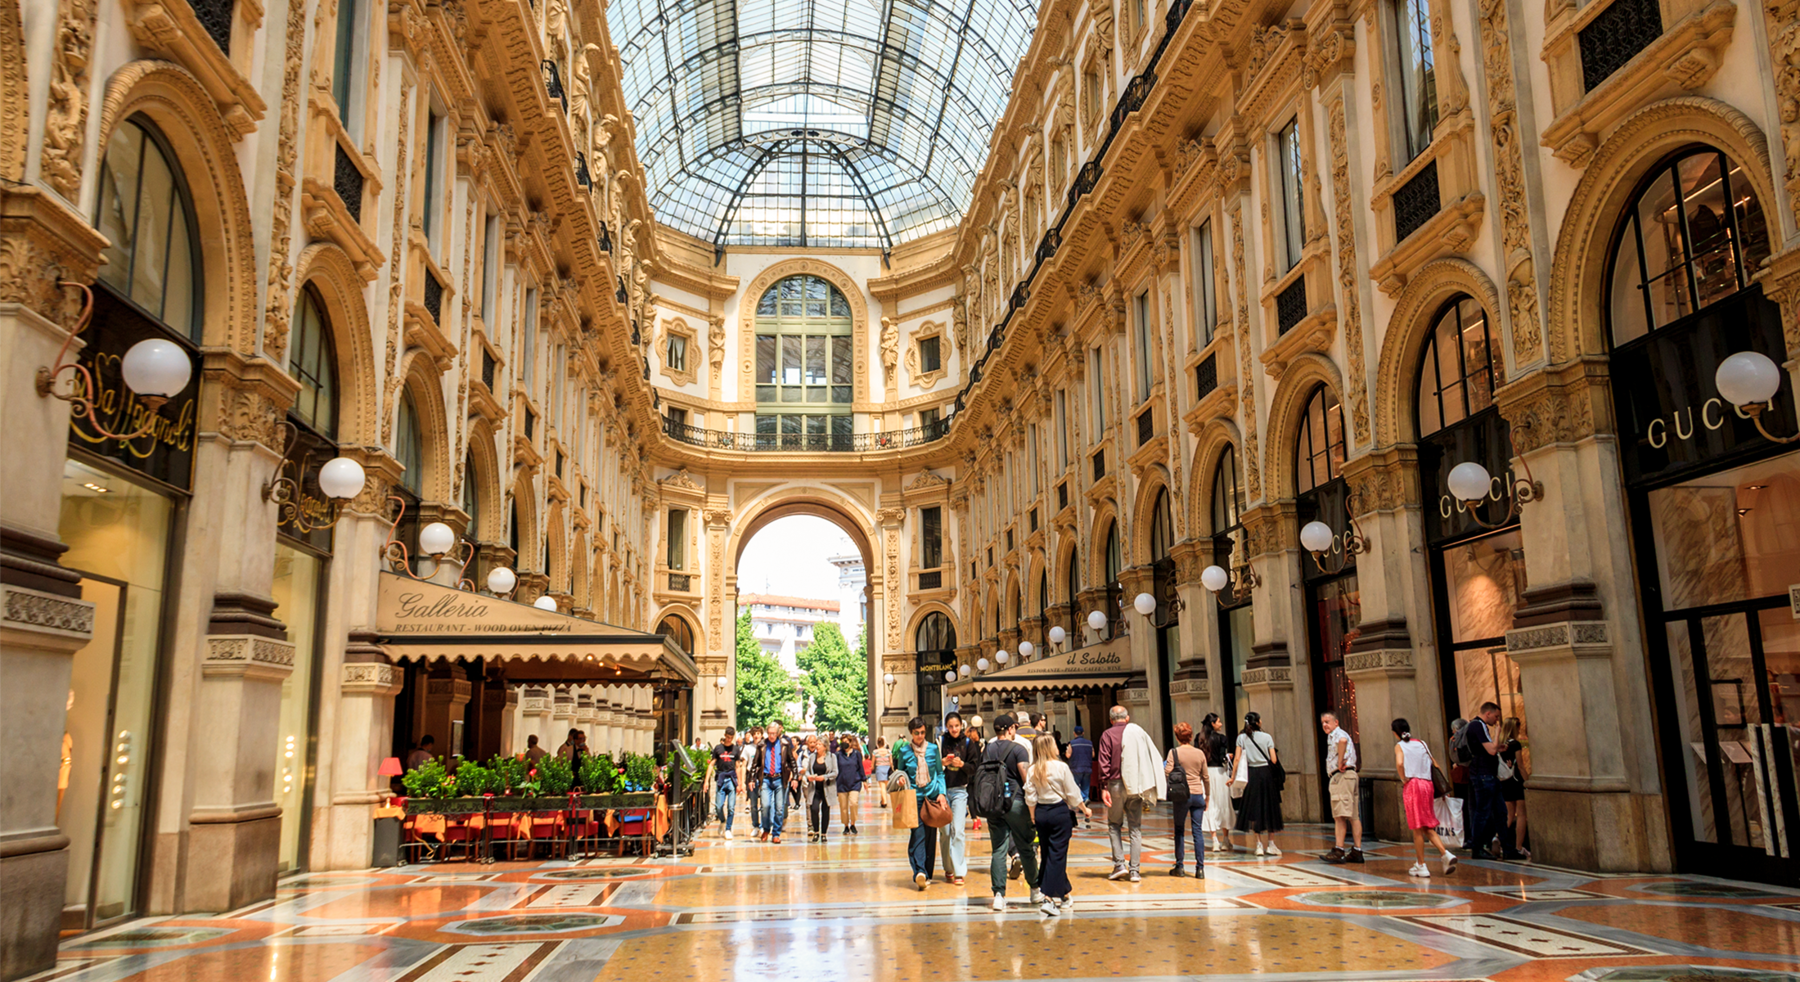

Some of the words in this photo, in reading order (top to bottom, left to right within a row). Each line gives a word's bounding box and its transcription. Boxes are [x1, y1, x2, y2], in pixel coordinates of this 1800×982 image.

[395, 592, 489, 618] Galleria
[395, 623, 466, 632] RESTAURANT
[474, 623, 507, 632] WOOD
[1067, 653, 1076, 665] il
[1080, 651, 1121, 665] Salotto
[920, 663, 953, 672] MONTBLANC
